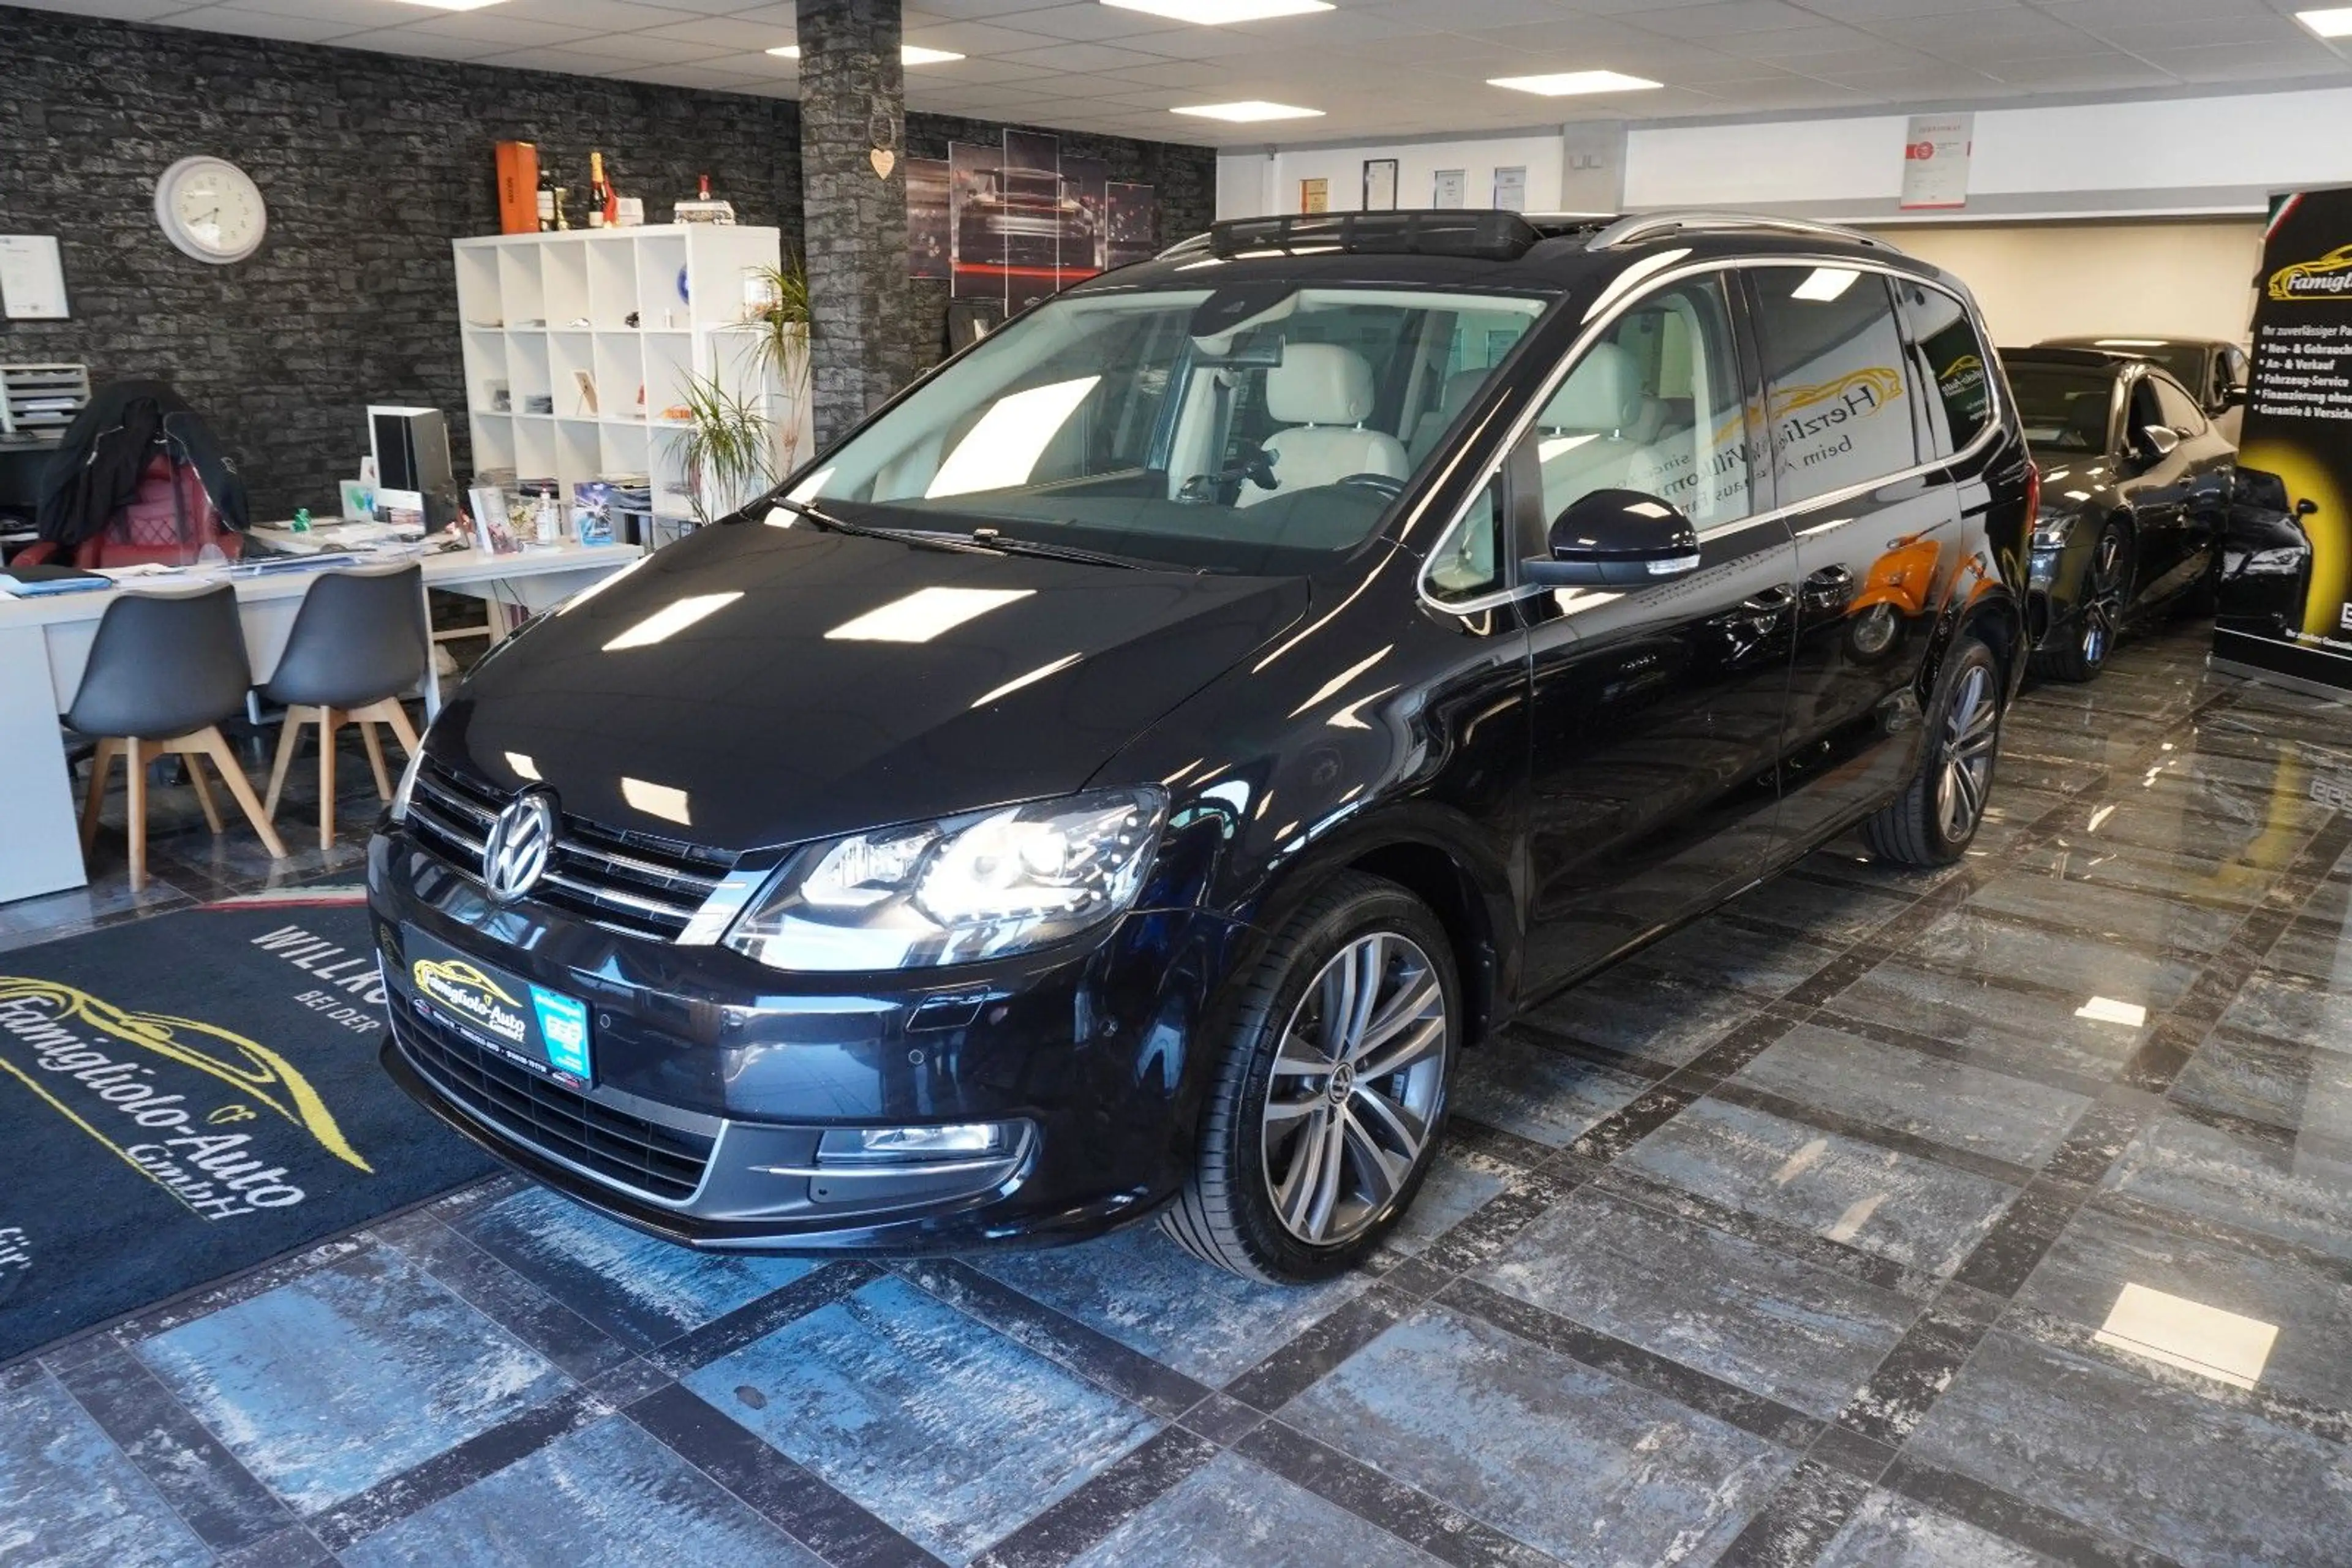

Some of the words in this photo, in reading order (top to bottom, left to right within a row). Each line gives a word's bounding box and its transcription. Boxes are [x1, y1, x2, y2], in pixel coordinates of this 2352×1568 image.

[2288, 270, 2352, 293] Famigl
[2296, 359, 2335, 370] Verkauf
[2262, 389, 2326, 405] Finanzierung
[2260, 404, 2303, 417] Garantie
[293, 990, 342, 1011] BEI
[326, 1008, 381, 1033] DER
[125, 1144, 255, 1221] GmbH
